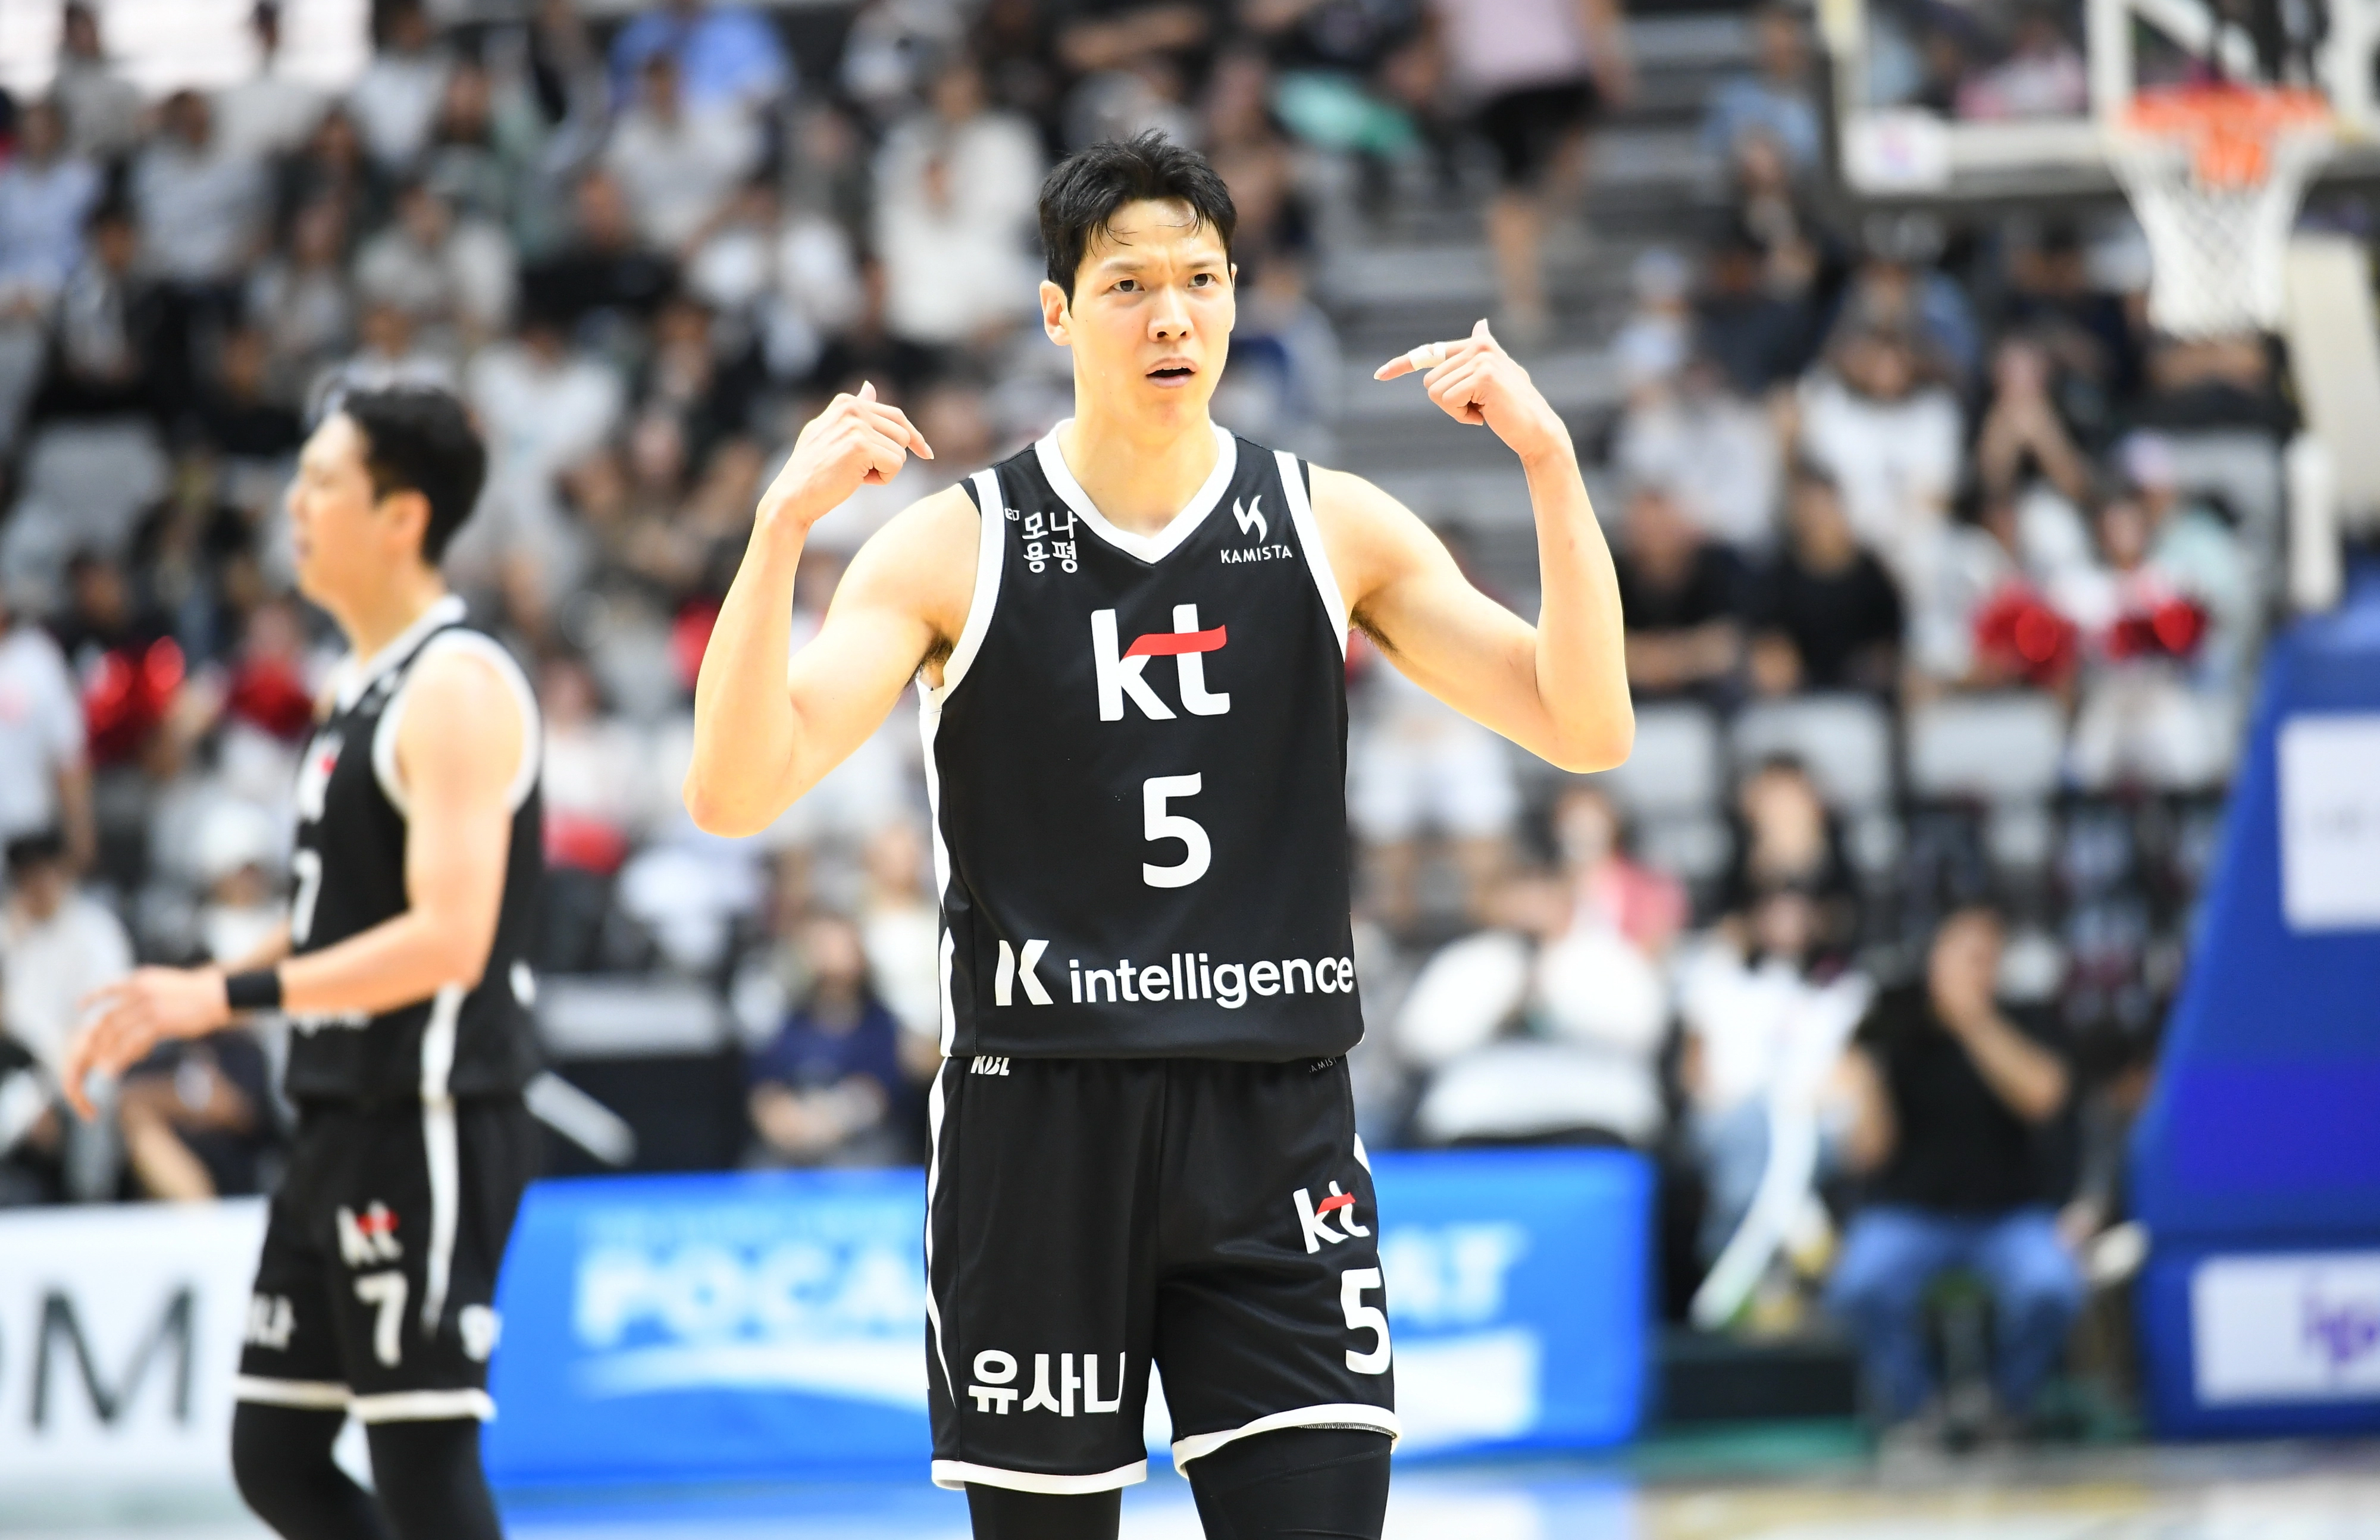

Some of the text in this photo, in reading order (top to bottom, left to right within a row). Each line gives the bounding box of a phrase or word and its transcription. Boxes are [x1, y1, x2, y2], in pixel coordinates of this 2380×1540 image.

[1022, 511, 1078, 539] 모나
[1023, 540, 1078, 573] 용평
[1220, 544, 1292, 564] KAMISTA
[1091, 603, 1230, 721] kt
[1142, 772, 1211, 888] 5
[1069, 953, 1354, 1009] intelligence
[1293, 1180, 1370, 1254] kt
[355, 1270, 409, 1367] 7
[575, 1238, 926, 1346] POCA
[1340, 1267, 1391, 1375] 5
